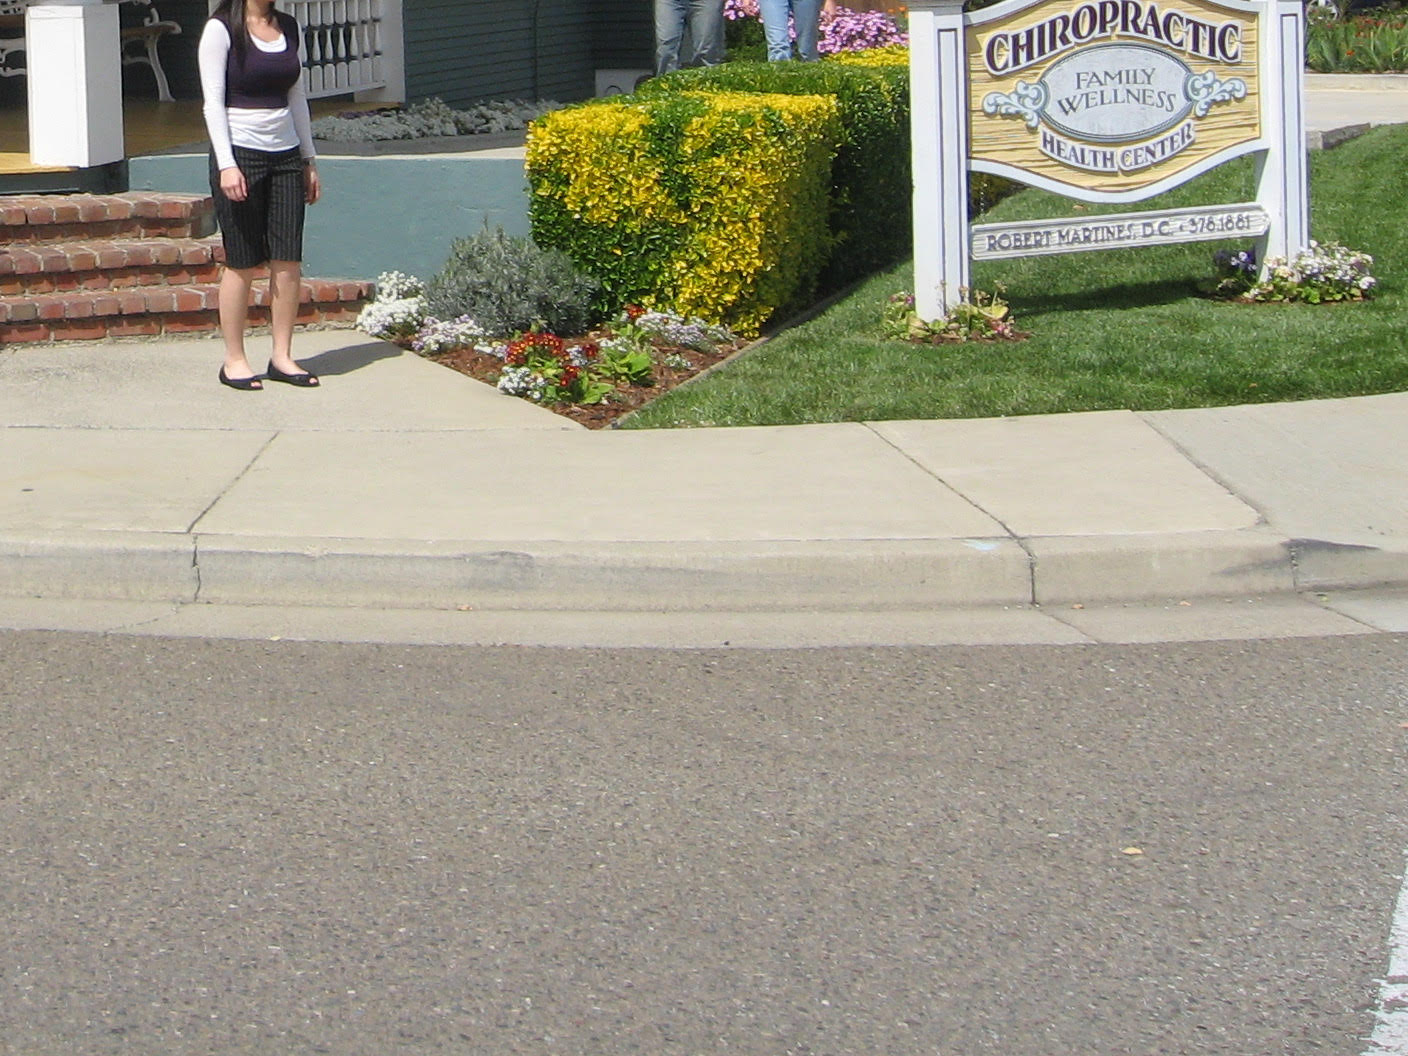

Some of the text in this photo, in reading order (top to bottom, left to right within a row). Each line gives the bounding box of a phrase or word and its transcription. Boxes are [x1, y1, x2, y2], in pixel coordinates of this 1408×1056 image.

[986, 0, 1240, 73] CHIROPRACTIC
[1076, 67, 1156, 90] FAMILY
[1057, 88, 1176, 116] WELLNESS
[1042, 122, 1193, 169] HEALTH CENTER
[986, 230, 1052, 252] ROBERT
[1057, 223, 1137, 245] MARTINES,
